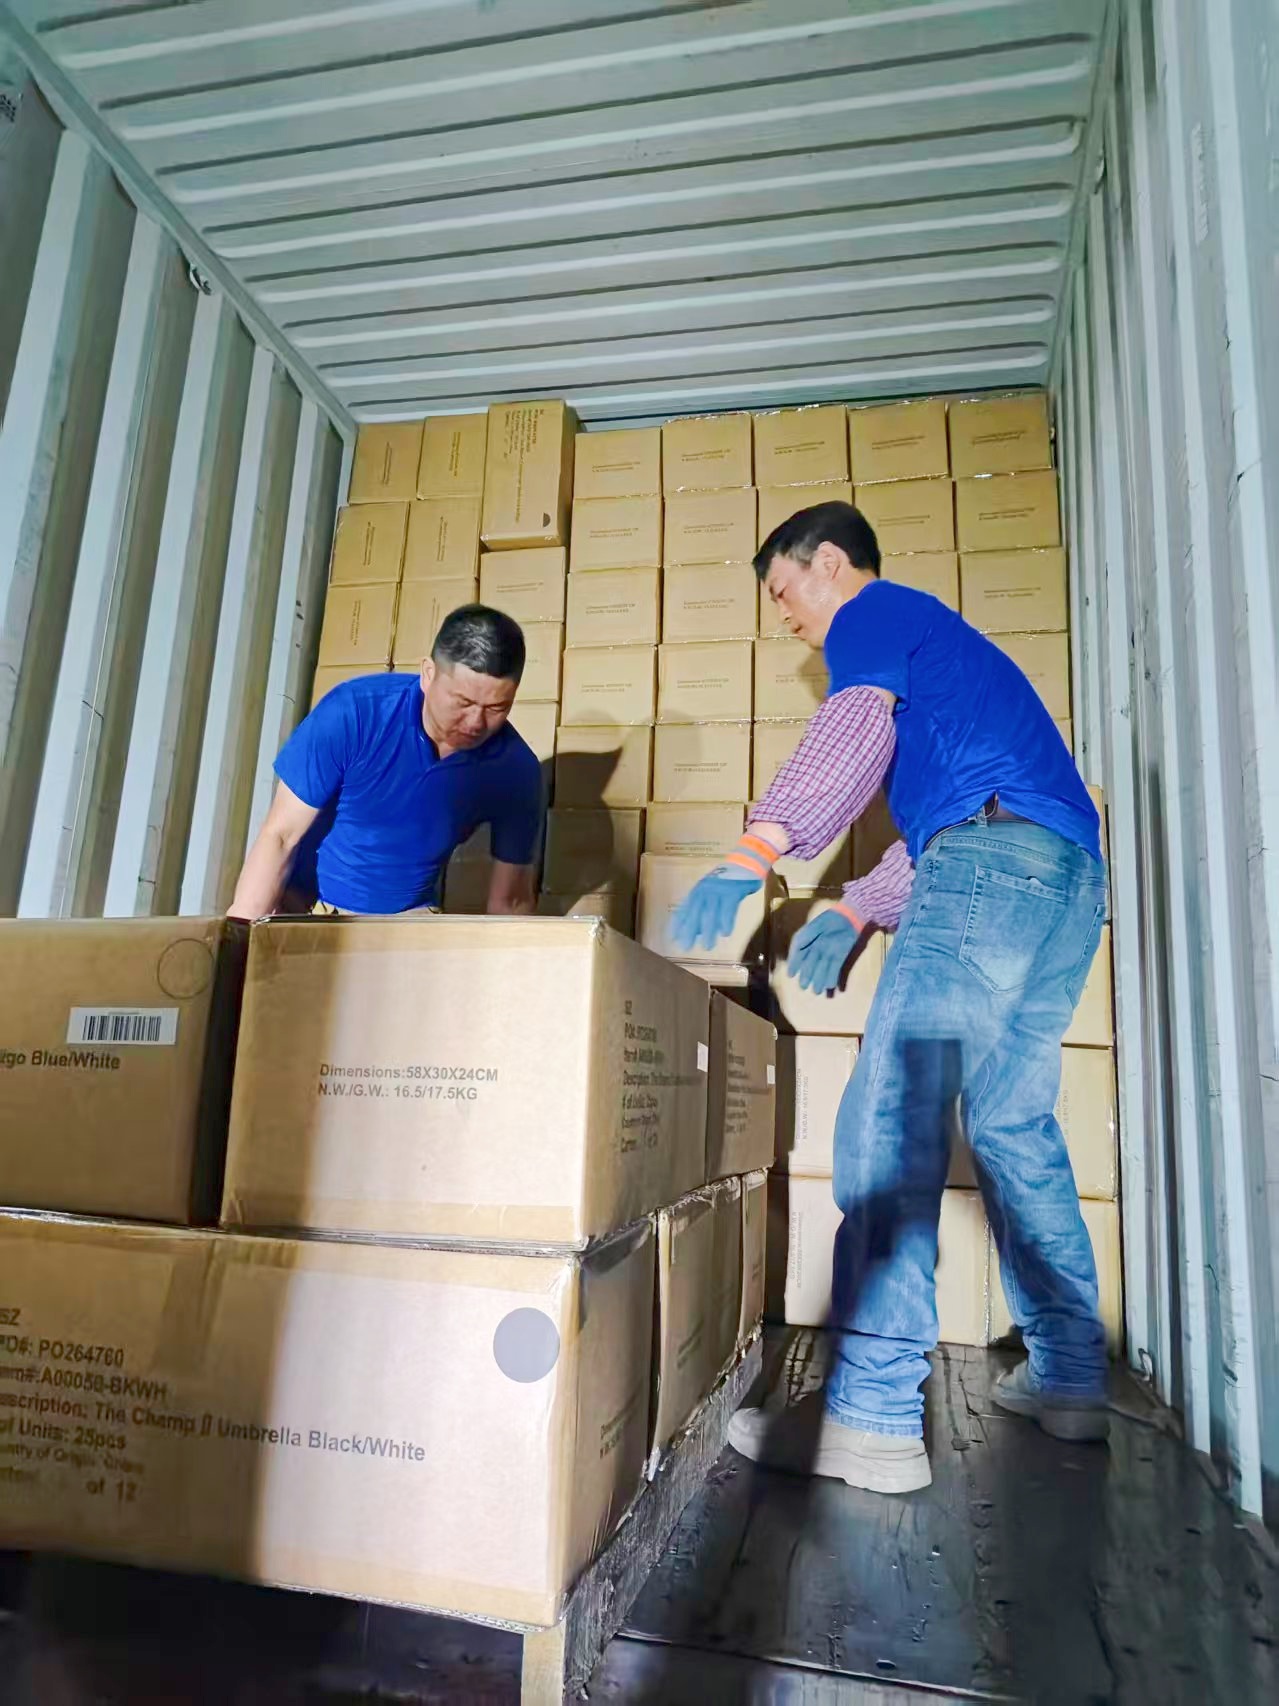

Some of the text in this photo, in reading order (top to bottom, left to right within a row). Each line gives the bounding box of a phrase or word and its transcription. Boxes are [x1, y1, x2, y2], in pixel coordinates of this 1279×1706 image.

[32, 1051, 121, 1069] Blue/White
[394, 1086, 478, 1100] 16.5/17.5KG
[96, 1401, 126, 1425] The
[132, 1407, 196, 1437] Champ
[218, 1421, 301, 1447] Umbrella
[308, 1430, 426, 1461] Black/White
